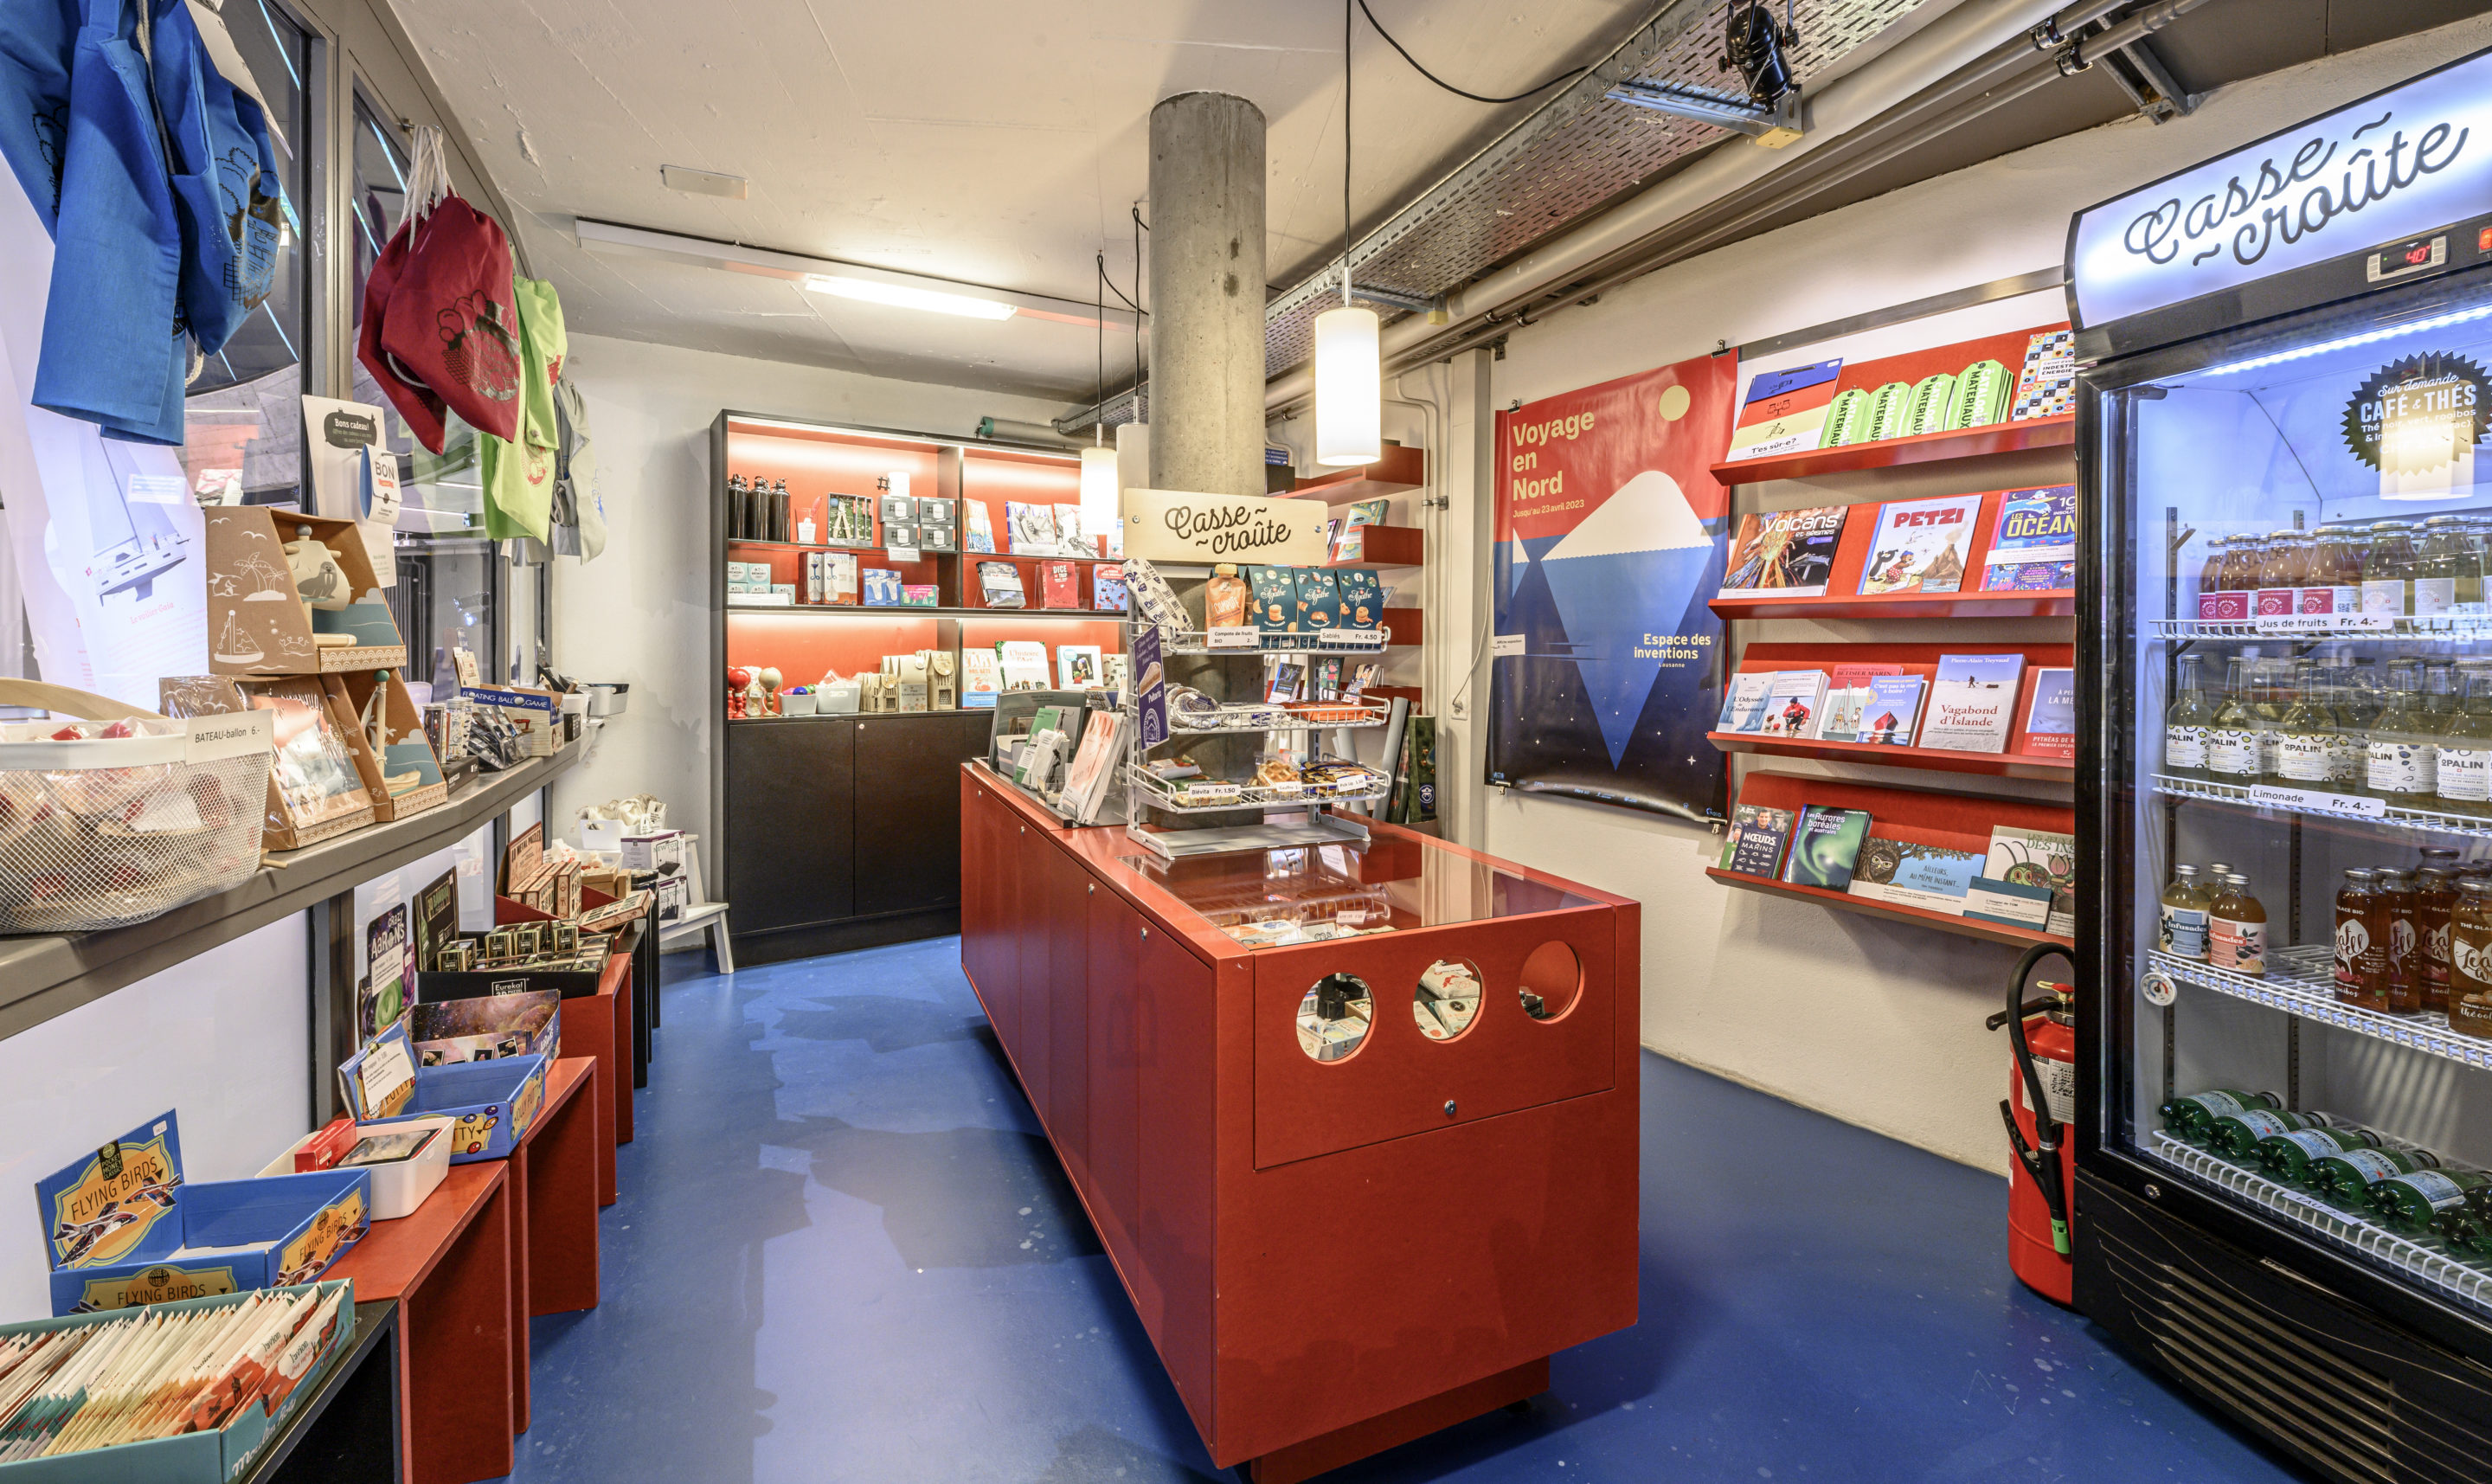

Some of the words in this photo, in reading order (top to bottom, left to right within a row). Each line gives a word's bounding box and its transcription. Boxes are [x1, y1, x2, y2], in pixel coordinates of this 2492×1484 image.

[2123, 137, 2338, 265] Casse
[2232, 122, 2469, 266] croûte
[2378, 382, 2402, 397] Sur
[2404, 372, 2459, 391] demande
[2360, 394, 2408, 422] CAFÉ
[2412, 399, 2421, 410] &
[2425, 384, 2476, 413] THÉS
[334, 419, 350, 428] Bons
[350, 421, 369, 431] cadeau!
[1828, 399, 1849, 447] MATERIAU
[2361, 421, 2380, 433] Thé
[2435, 409, 2476, 421] rooibos
[1513, 412, 1595, 446] Voyage
[1513, 452, 1537, 472] en
[375, 461, 395, 480] BON
[1513, 471, 1563, 501] Nord
[1513, 507, 1540, 517] Jusqu'au
[1542, 504, 1551, 513] 23
[1551, 503, 1564, 512] avril
[1565, 499, 1584, 510] 2023
[1165, 506, 1251, 539] Casse
[1893, 508, 1966, 528] PETZI
[1212, 519, 1291, 555] croûte
[1052, 565, 1067, 574] DICE
[2259, 620, 2278, 628] Jus
[2296, 619, 2328, 627] fruits
[2340, 618, 2357, 626] Fr.
[2360, 617, 2379, 626] 4.-
[1643, 633, 1688, 647] Espace
[1691, 633, 1712, 646] des
[1634, 646, 1699, 659] inventions
[498, 695, 513, 703] BALL
[524, 699, 548, 708] GAME
[1941, 704, 1999, 716] Vagabond
[1940, 716, 1994, 726] d'Islande
[195, 728, 247, 742] BATEAU-ballon
[251, 726, 260, 735] 6.-
[2253, 789, 2304, 803] Limonade
[2332, 798, 2348, 808] Fr.
[2352, 801, 2371, 811] 4.-
[1807, 819, 1841, 831] boréales
[1814, 813, 1846, 823] Aurores
[1743, 832, 1777, 846] NŒUDS
[2026, 838, 2052, 851] DES
[1741, 843, 1774, 853] MARINS
[2168, 921, 2207, 932] Infusades
[2209, 931, 2244, 944] nfusades
[495, 981, 523, 991] Eureka!
[101, 1154, 120, 1167] POCKET
[103, 1161, 123, 1173] MONEY
[71, 1180, 118, 1221] FLYING
[121, 1156, 157, 1191] BIRDS
[2295, 1195, 2318, 1208] EAU
[299, 1234, 324, 1261] FLYING
[326, 1212, 347, 1240] BIRDS
[118, 1288, 162, 1305] FLYING
[167, 1284, 206, 1301] BIRDS
